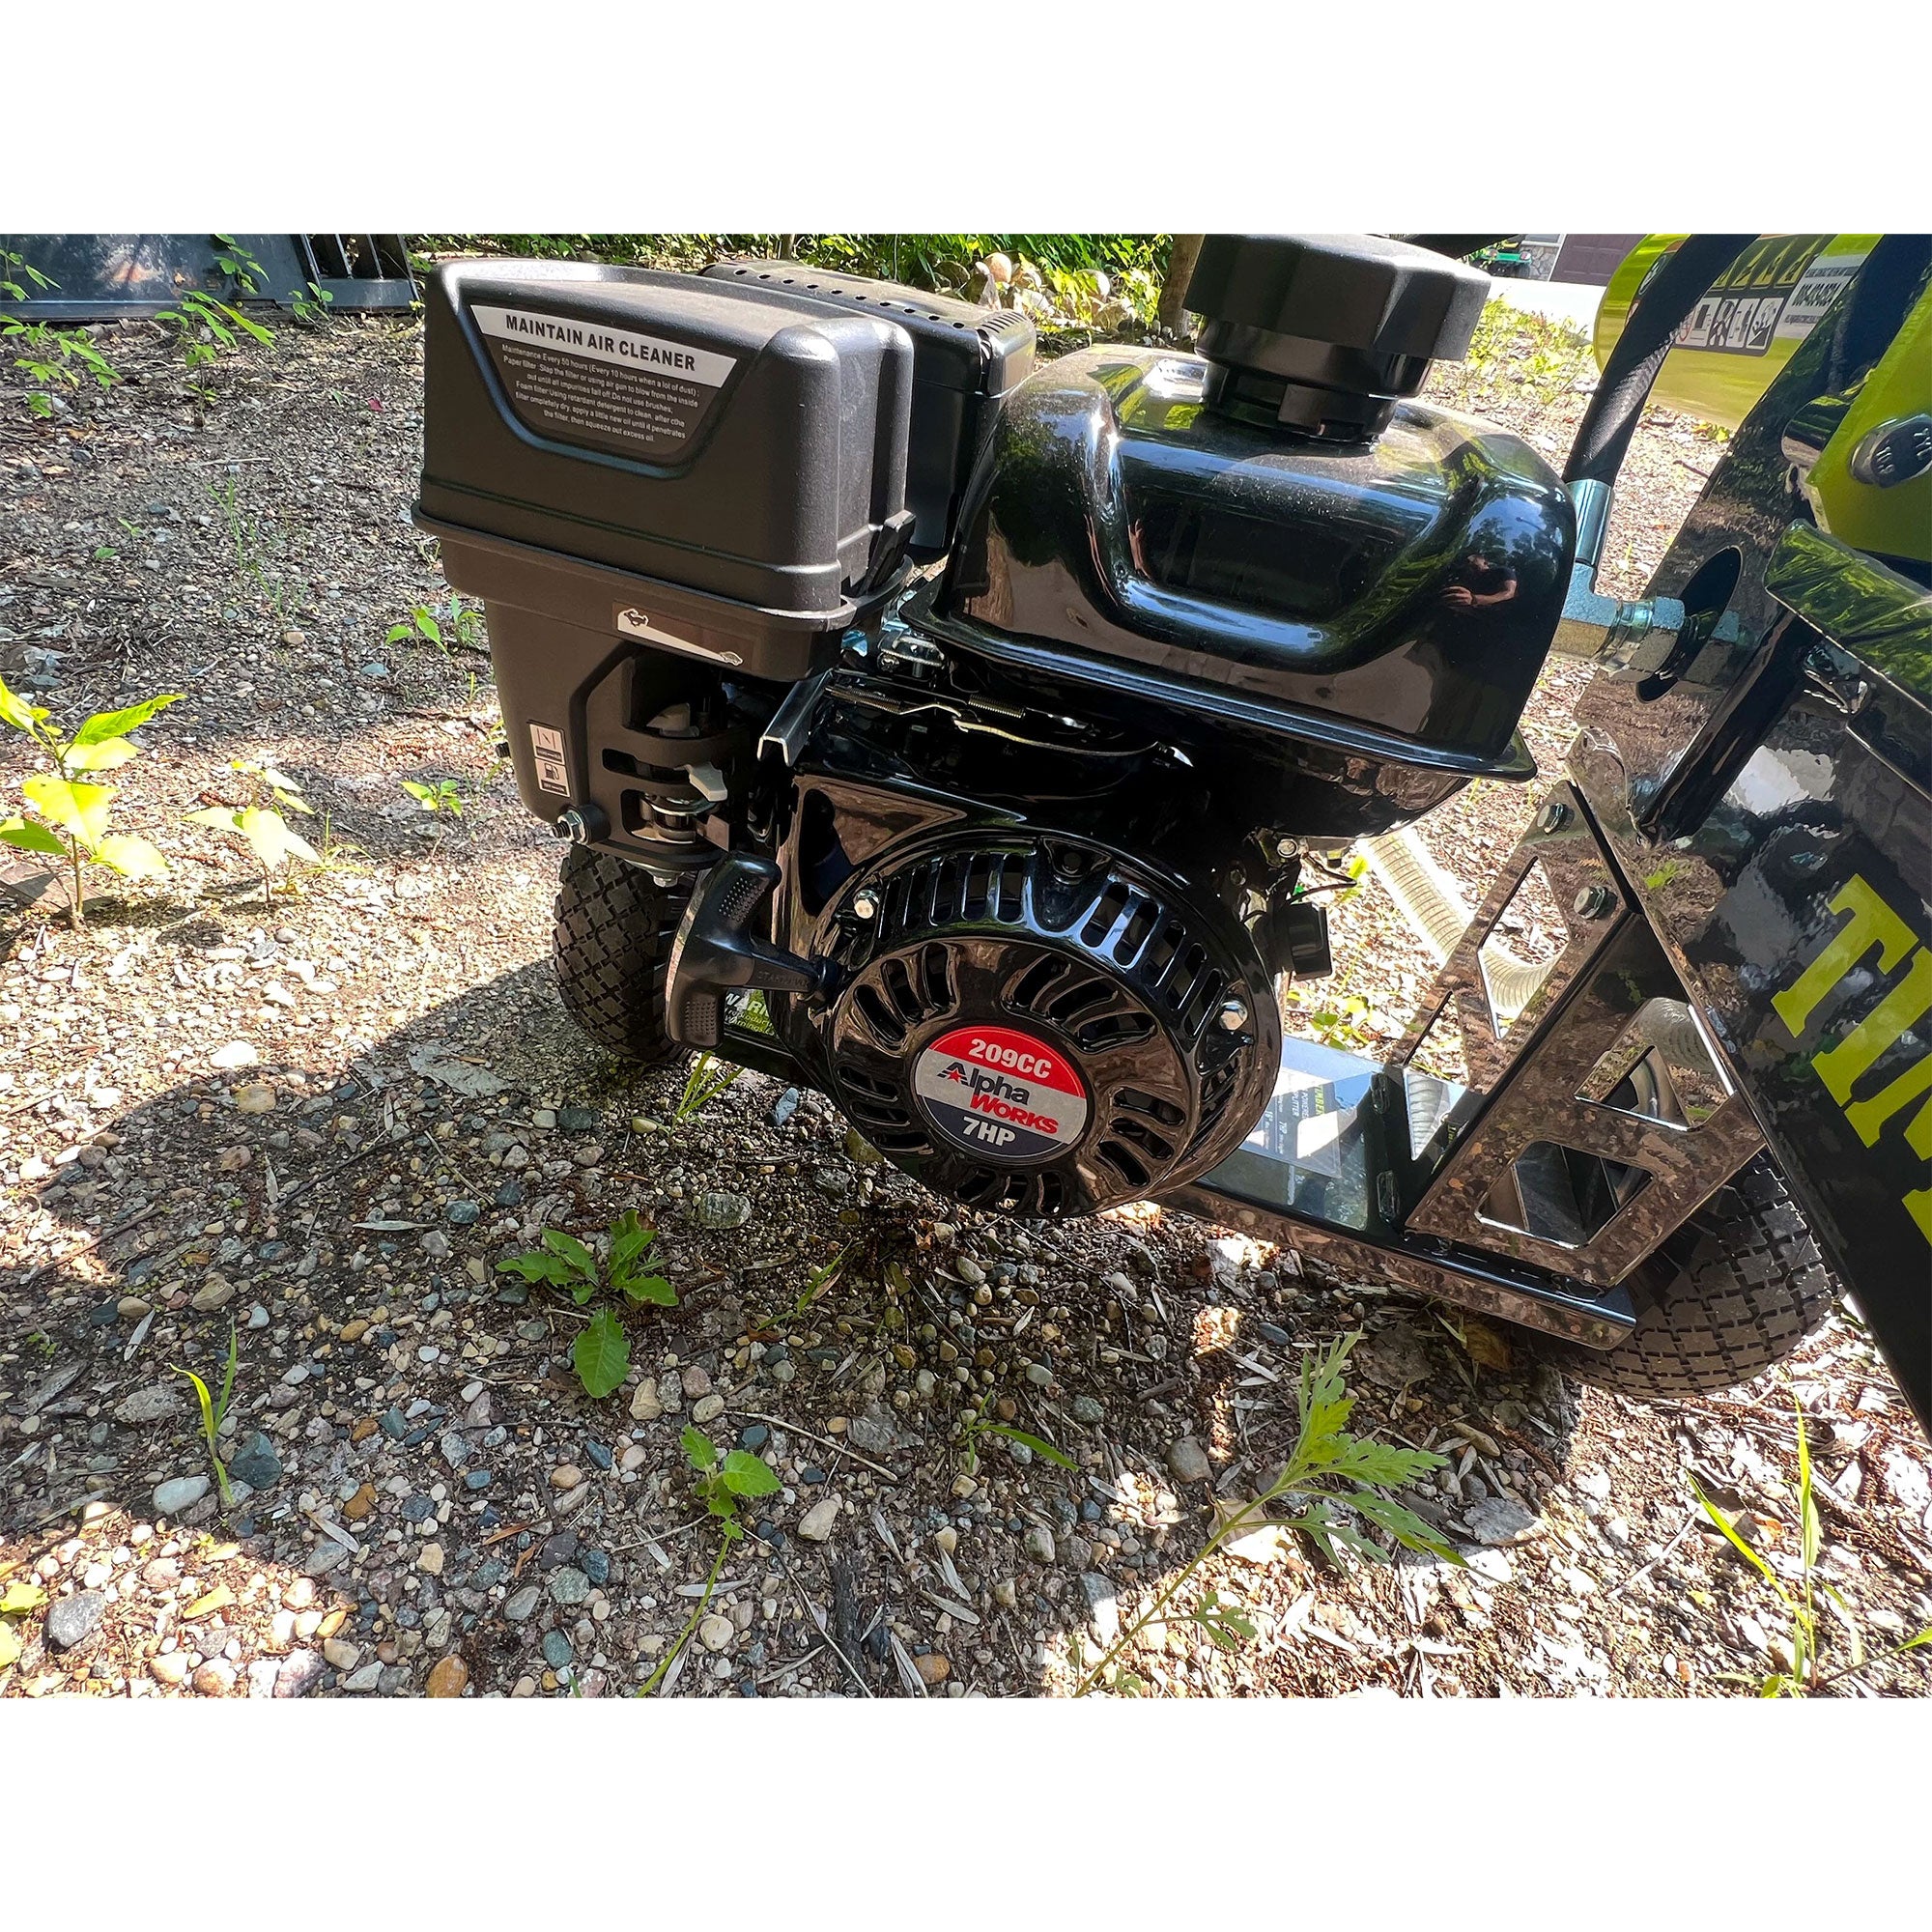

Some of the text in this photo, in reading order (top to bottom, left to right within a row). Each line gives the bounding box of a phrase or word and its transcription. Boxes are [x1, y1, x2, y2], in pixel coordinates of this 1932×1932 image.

[505, 314, 696, 371] MAINTAIN AIR CLEANER
[503, 355, 522, 367] Paper
[565, 370, 579, 380] filter
[588, 376, 605, 386] using
[614, 384, 627, 392] gun
[635, 387, 650, 396] blow
[651, 390, 667, 400] from
[667, 394, 678, 403] the
[678, 397, 698, 408] inside
[542, 353, 559, 365] Every
[571, 360, 587, 370] hours
[589, 365, 610, 376] (Every
[619, 372, 638, 382] hours
[638, 376, 655, 385] when
[516, 381, 532, 390] Foam
[568, 394, 595, 406] retardant
[596, 401, 626, 414] detergent
[655, 414, 669, 423] after
[538, 375, 551, 384] until
[622, 395, 633, 404] not
[515, 391, 529, 400] filter
[573, 406, 589, 416] apply
[595, 412, 608, 420] little
[631, 420, 645, 429] until
[651, 425, 686, 440] penetrates
[544, 409, 553, 417] the
[571, 416, 583, 425] then
[585, 420, 611, 433] squeeze
[623, 430, 644, 440] excess
[968, 1038, 1052, 1079] 209CC
[936, 1062, 1030, 1106] Alpha
[970, 1094, 1059, 1134] WORKS
[1301, 1091, 1310, 1119] POWERE
[963, 1116, 1015, 1147] 7HP
